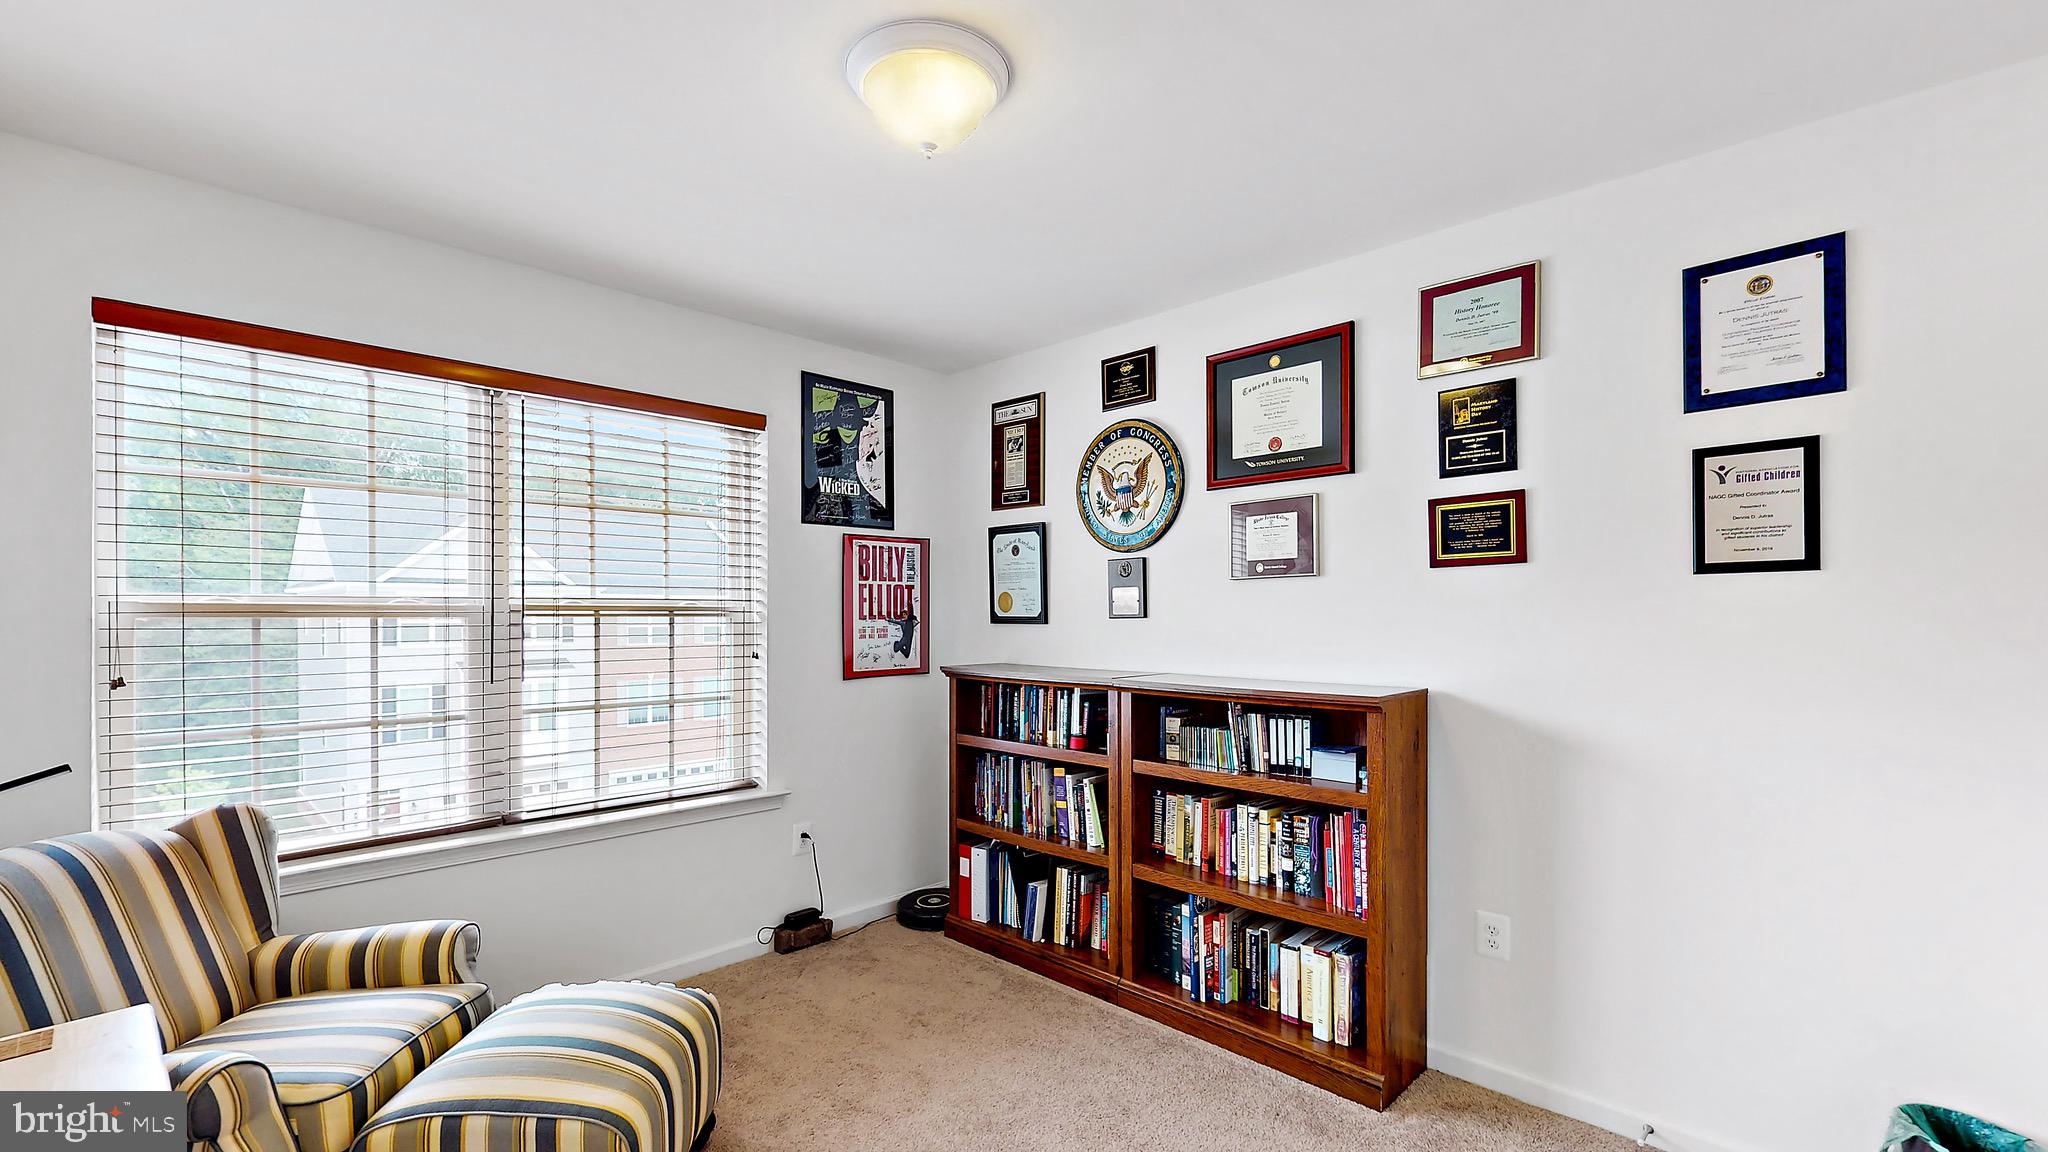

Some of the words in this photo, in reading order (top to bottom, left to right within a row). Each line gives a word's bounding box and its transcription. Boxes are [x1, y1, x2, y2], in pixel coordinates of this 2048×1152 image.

[1476, 302, 1500, 310] Honoree
[1242, 381, 1270, 396] Towson
[1272, 376, 1309, 384] University
[1470, 399, 1498, 407] MARYLAND
[998, 411, 1009, 419] THE
[1081, 442, 1106, 484] MEMBER
[1110, 429, 1122, 440] OF
[1130, 428, 1172, 467] CONGRESS
[1276, 456, 1305, 464] UNIVERSITY
[1736, 472, 1760, 483] Gifted
[1764, 470, 1801, 481] Children
[818, 476, 860, 496] WICKED
[858, 544, 906, 582] BILLY
[906, 548, 915, 573] MUSICAL
[906, 574, 915, 582] THE
[858, 584, 915, 620] ELLIOT
[1355, 858, 1361, 867] OF
